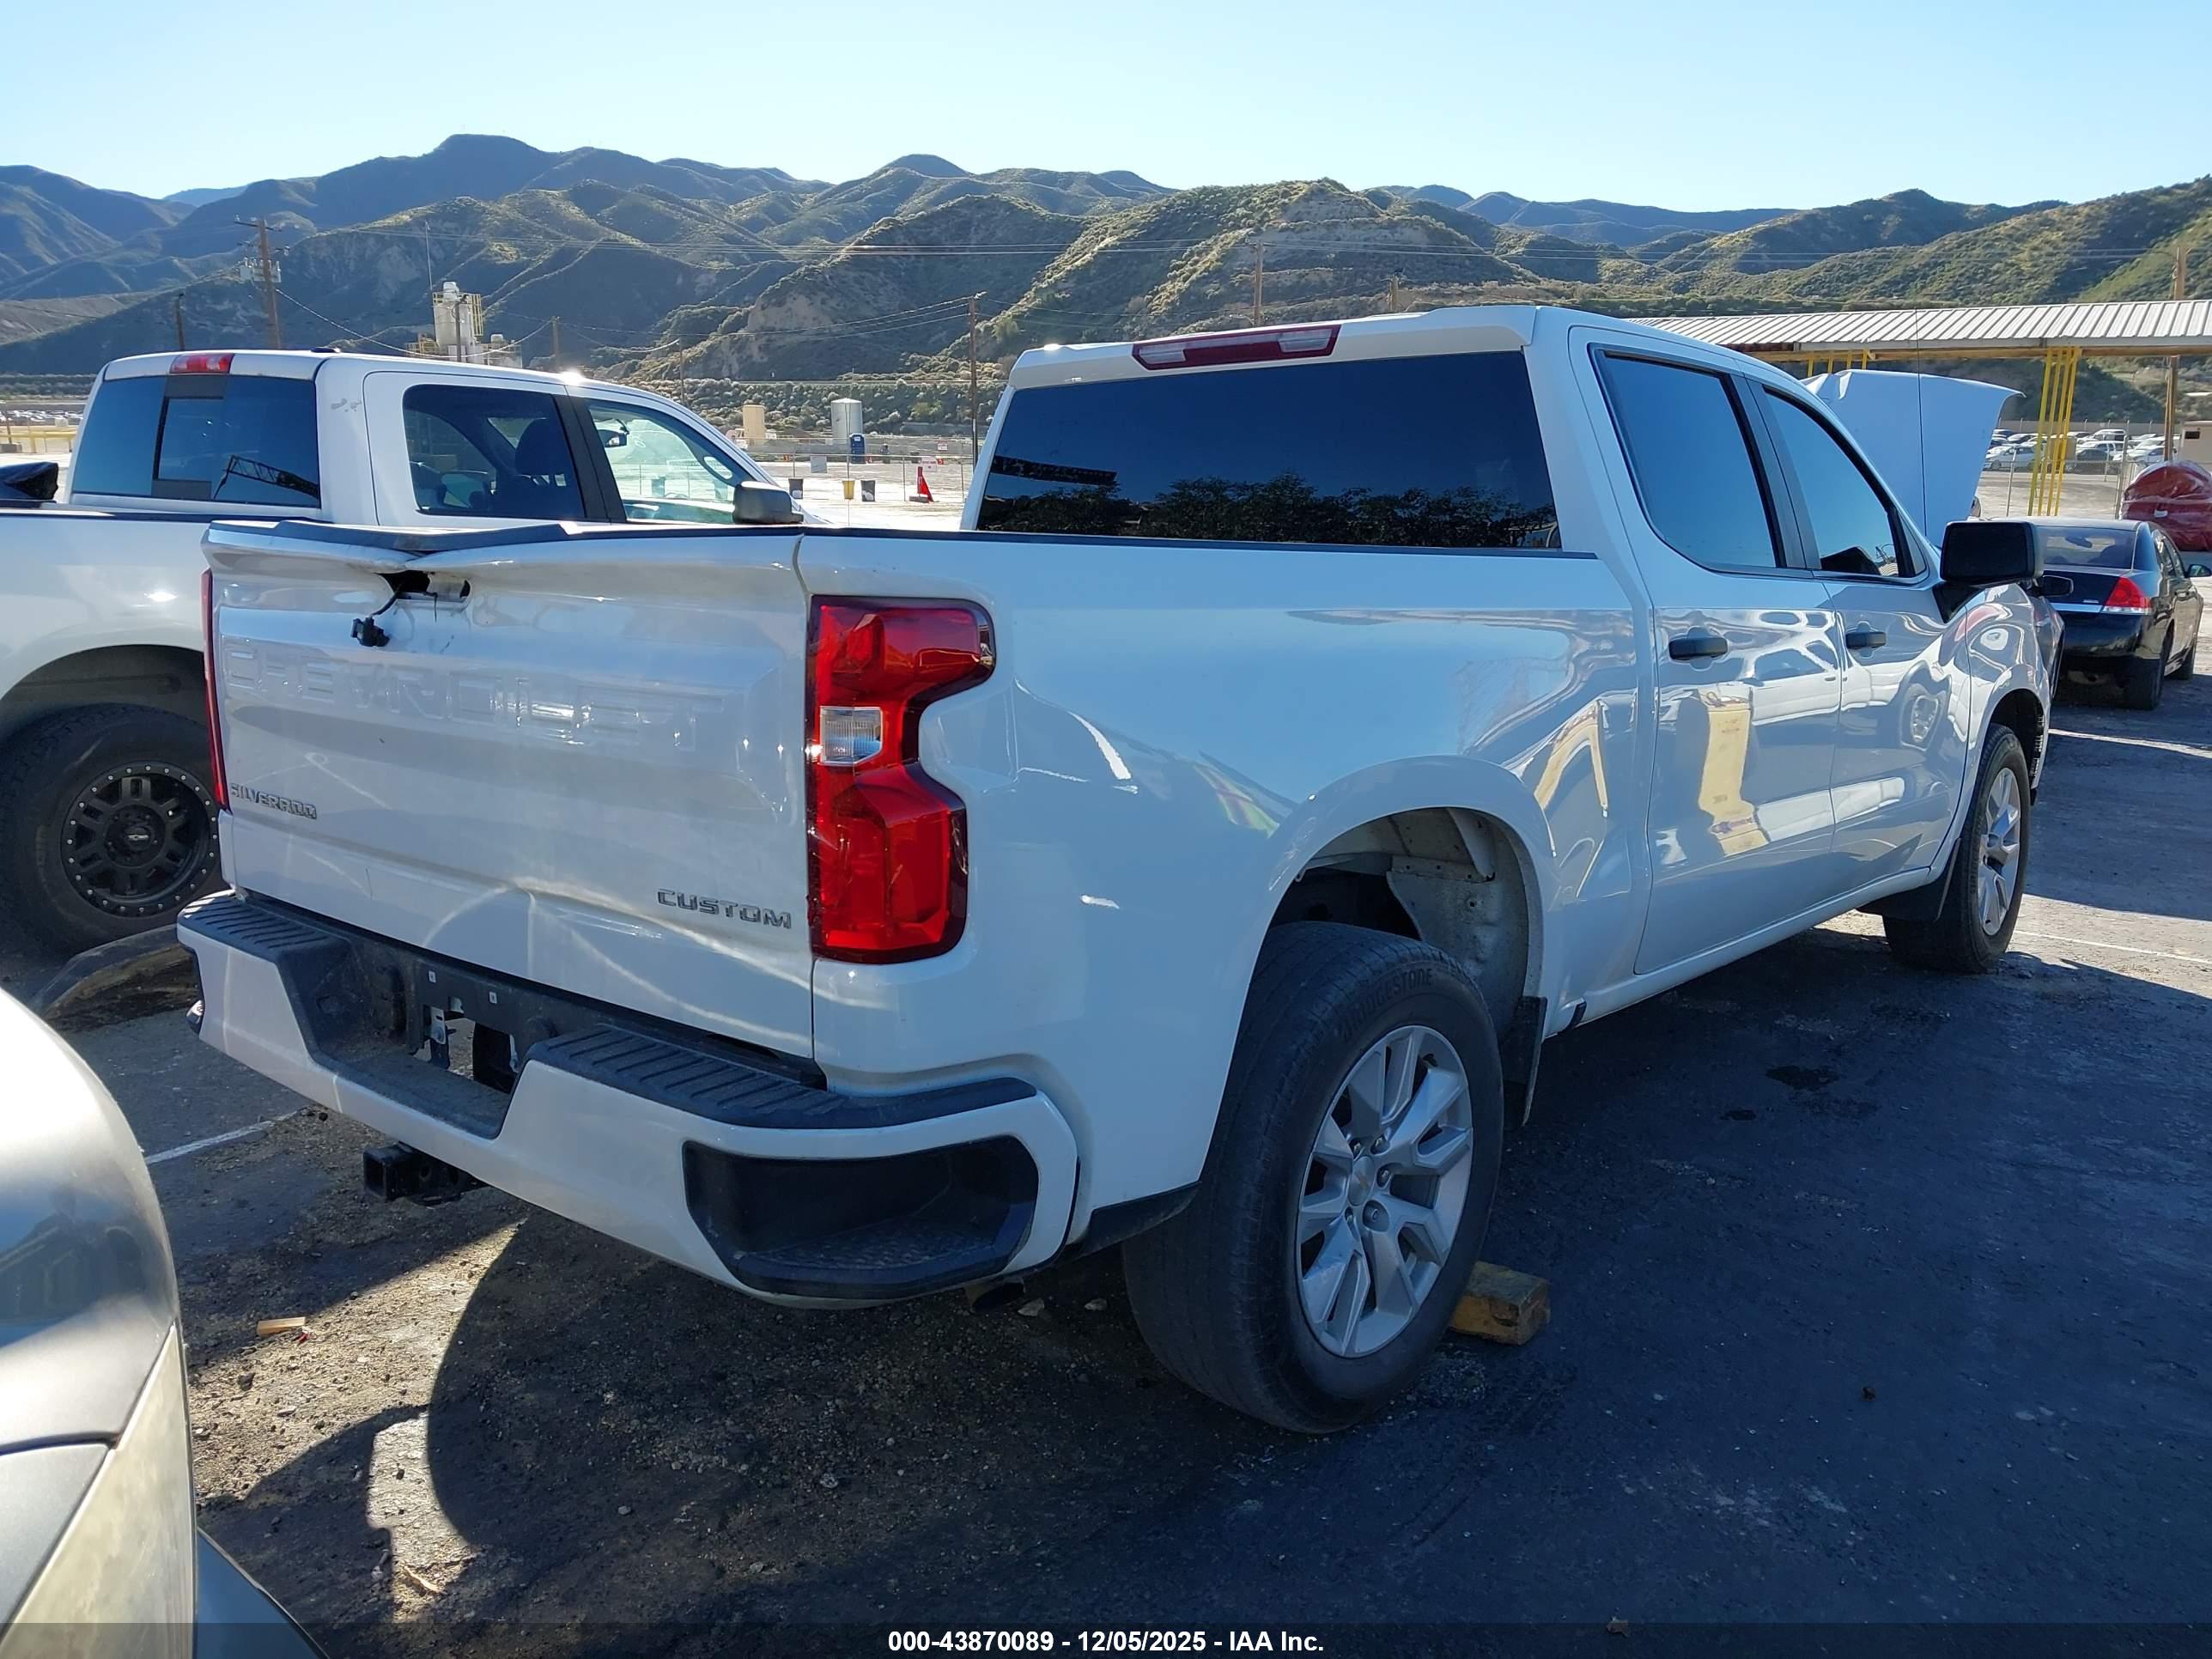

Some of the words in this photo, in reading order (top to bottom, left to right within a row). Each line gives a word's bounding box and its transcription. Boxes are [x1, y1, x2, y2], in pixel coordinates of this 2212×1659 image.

[225, 646, 725, 752] CHEVROLET
[230, 782, 318, 820] SILVERADO
[657, 888, 793, 929] CUSTOM
